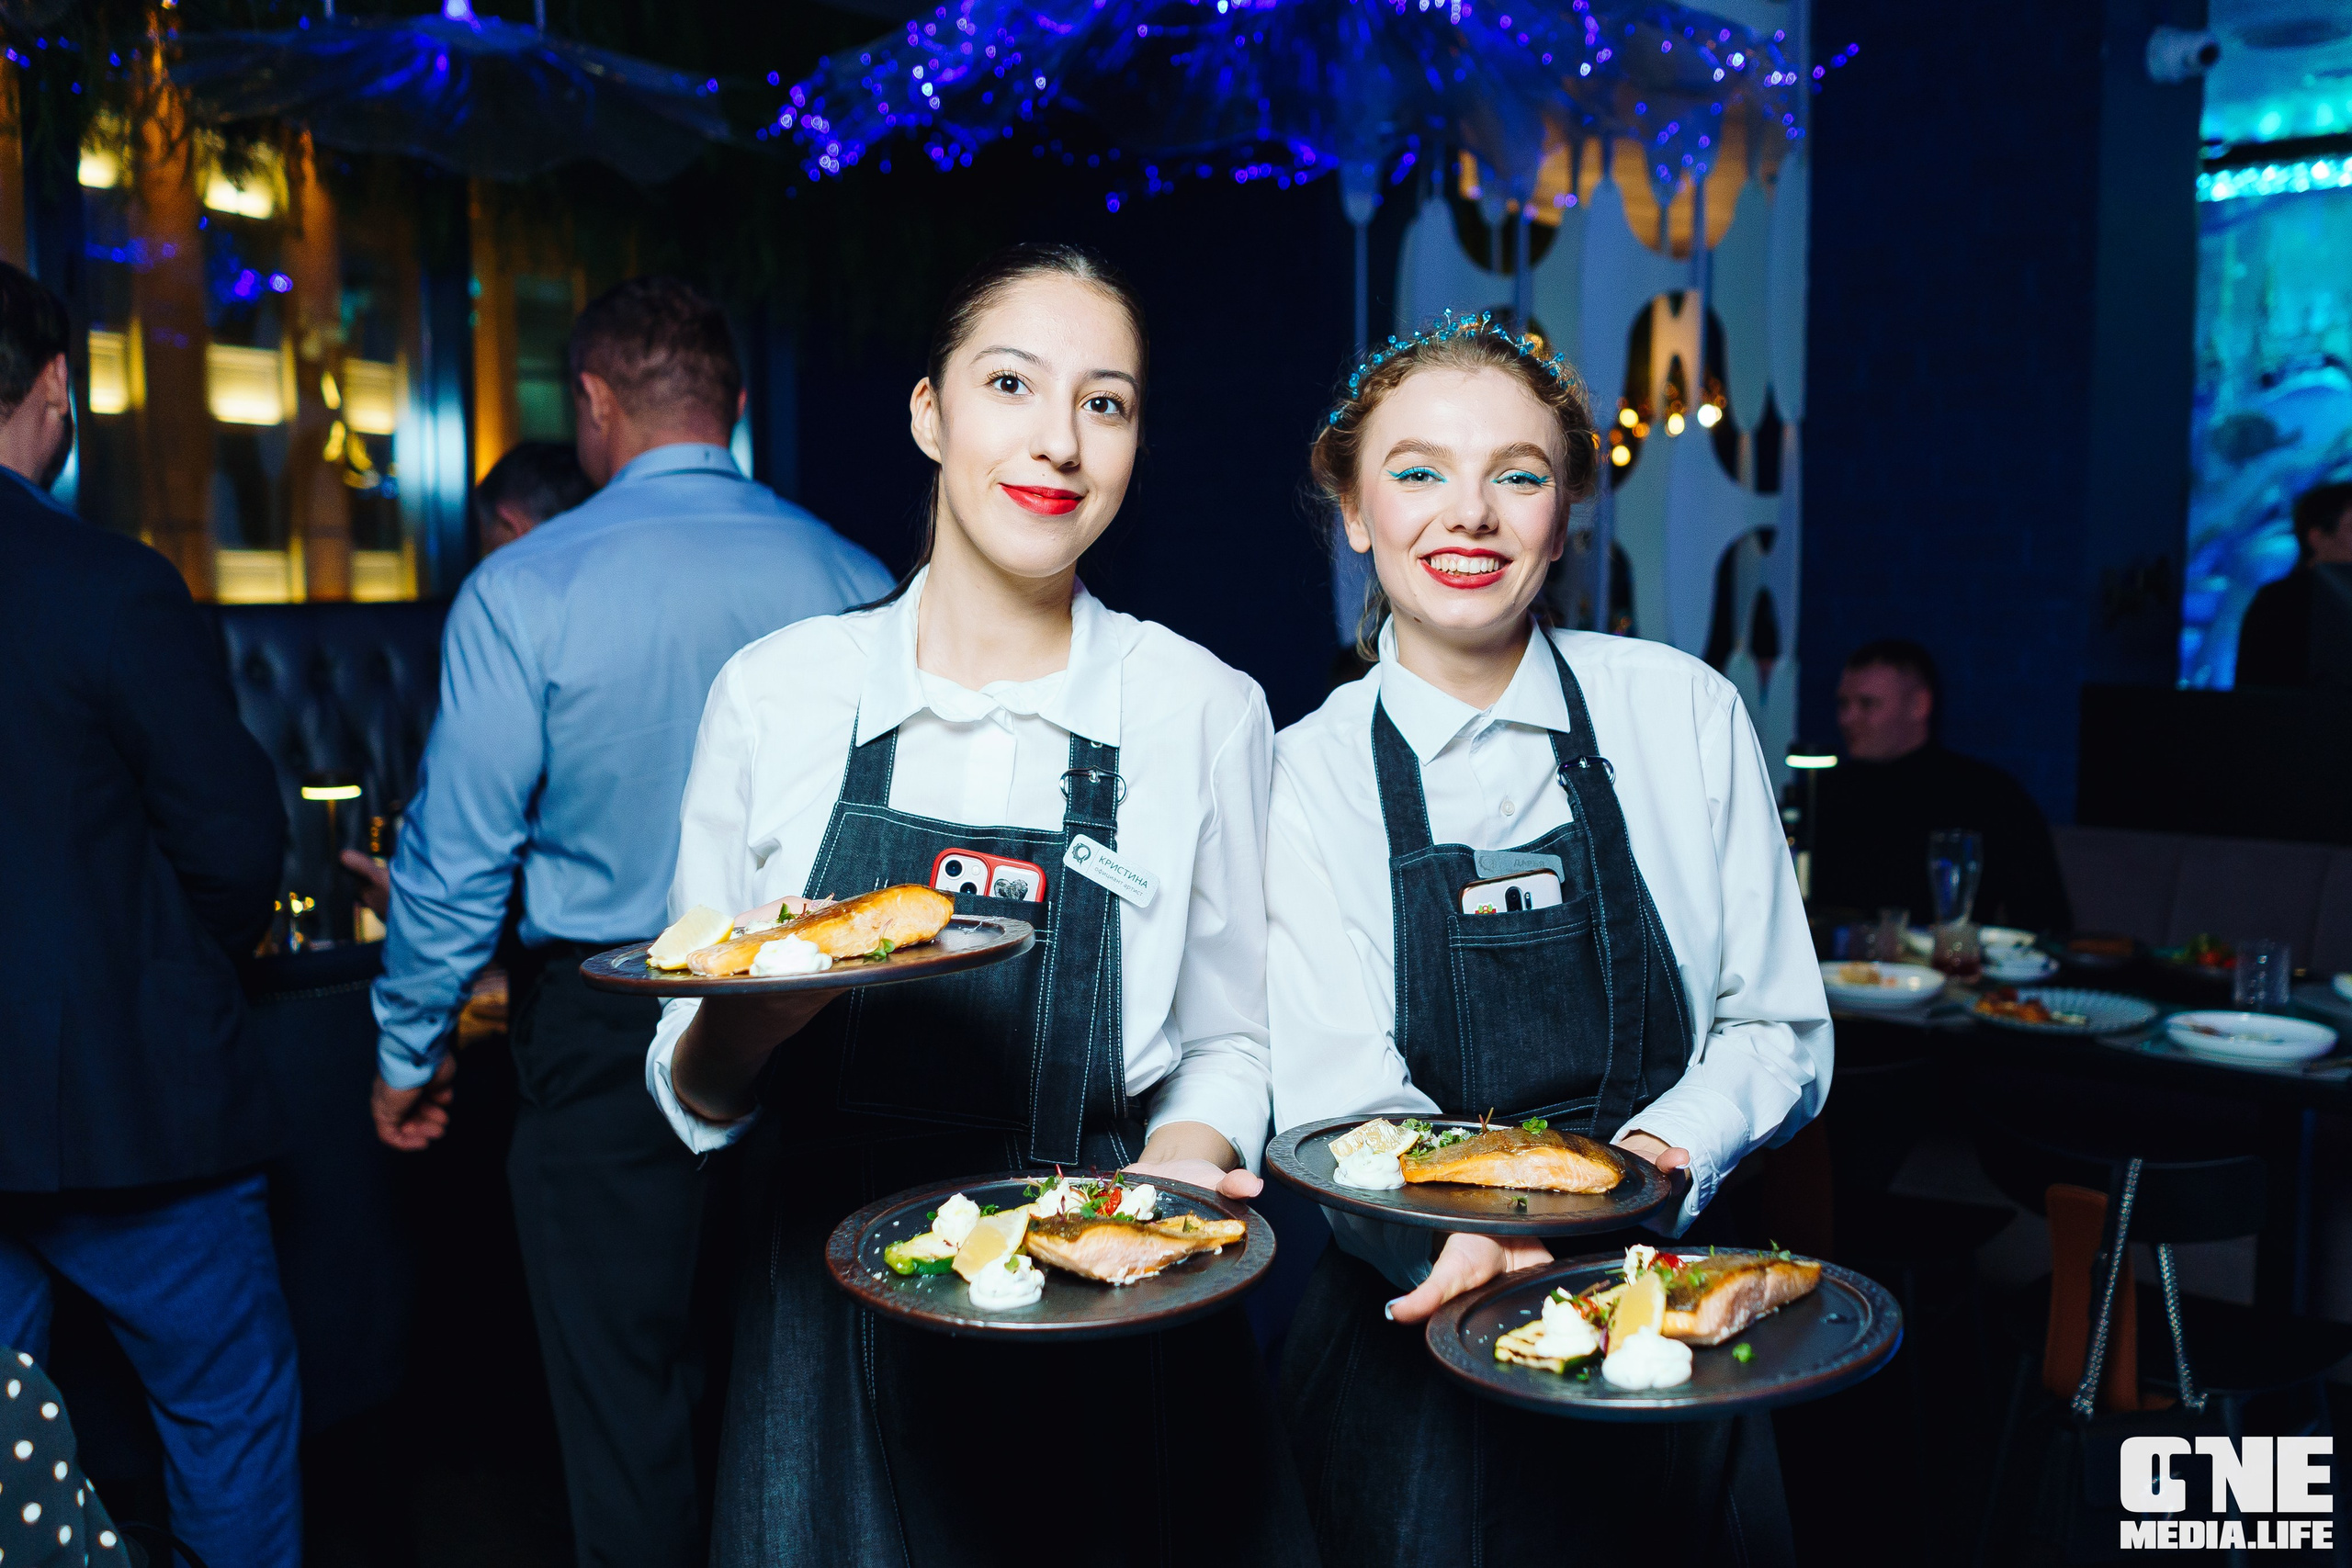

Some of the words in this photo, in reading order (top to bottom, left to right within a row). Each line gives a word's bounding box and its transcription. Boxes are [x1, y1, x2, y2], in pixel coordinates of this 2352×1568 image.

[1094, 867, 1124, 886] официант
[1124, 884, 1143, 897] артист
[1099, 855, 1148, 888] КРИСТИНА
